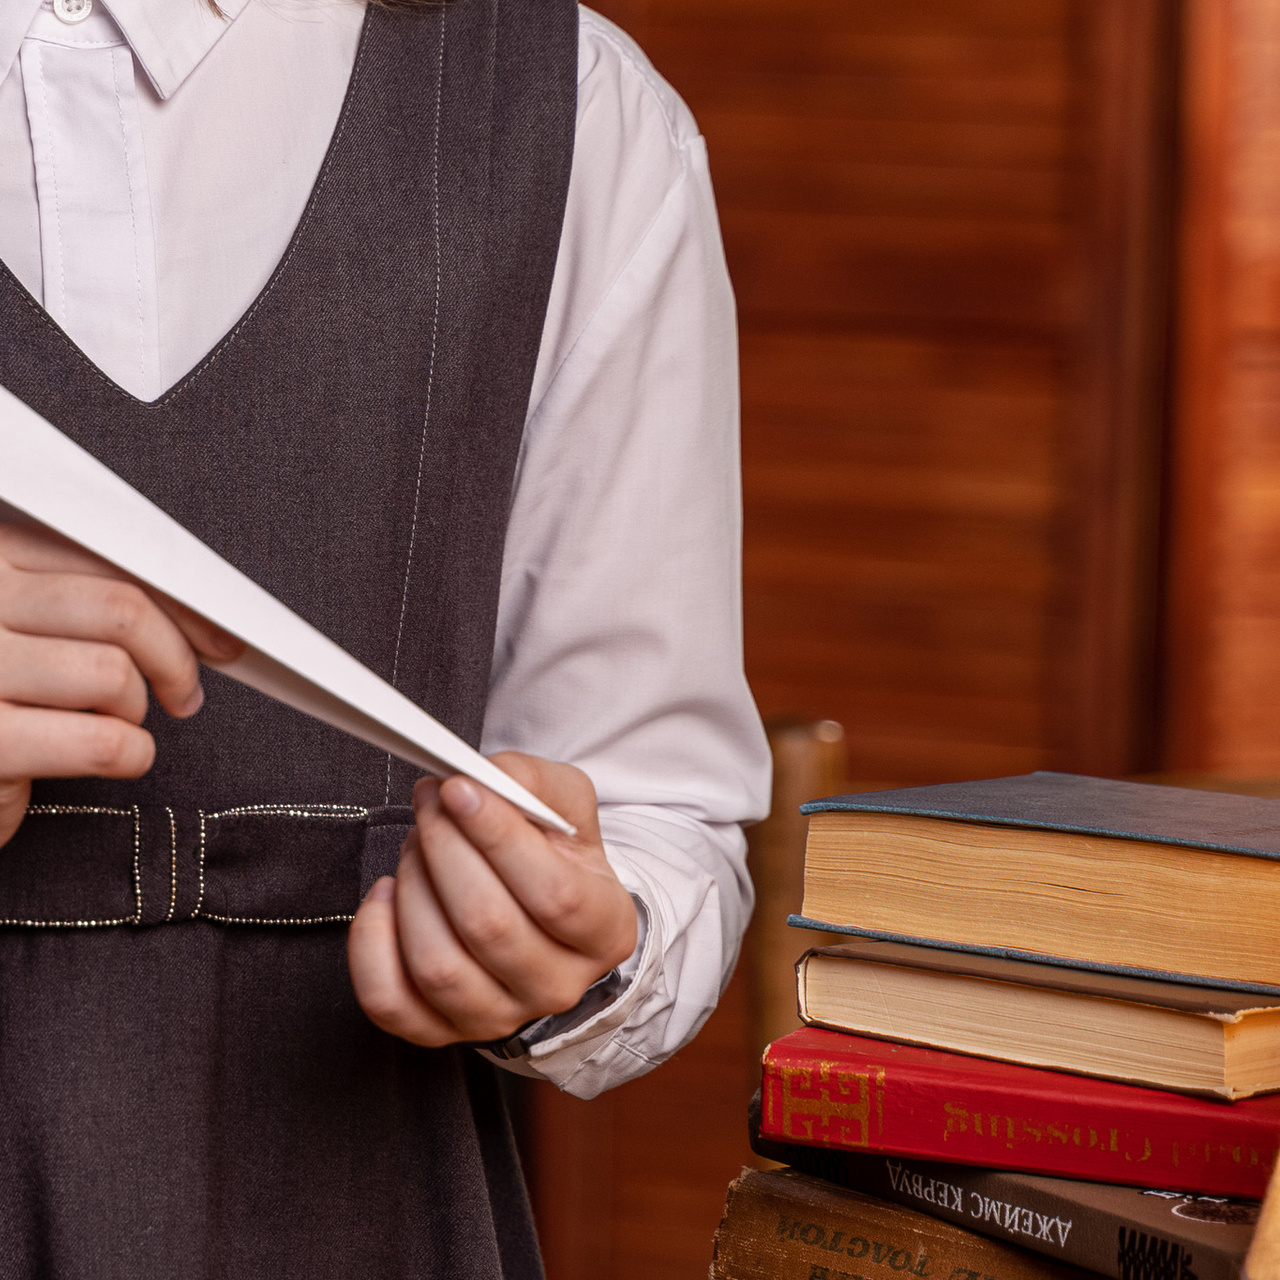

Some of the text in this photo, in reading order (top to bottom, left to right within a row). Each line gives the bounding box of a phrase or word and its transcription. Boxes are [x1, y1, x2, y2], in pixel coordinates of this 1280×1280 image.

[943, 1101, 1153, 1163] Crossing
[885, 1159, 1073, 1248] ДЖЕЙМС КЕРВУД
[775, 1217, 933, 1278] ТОЛСТОЙ
